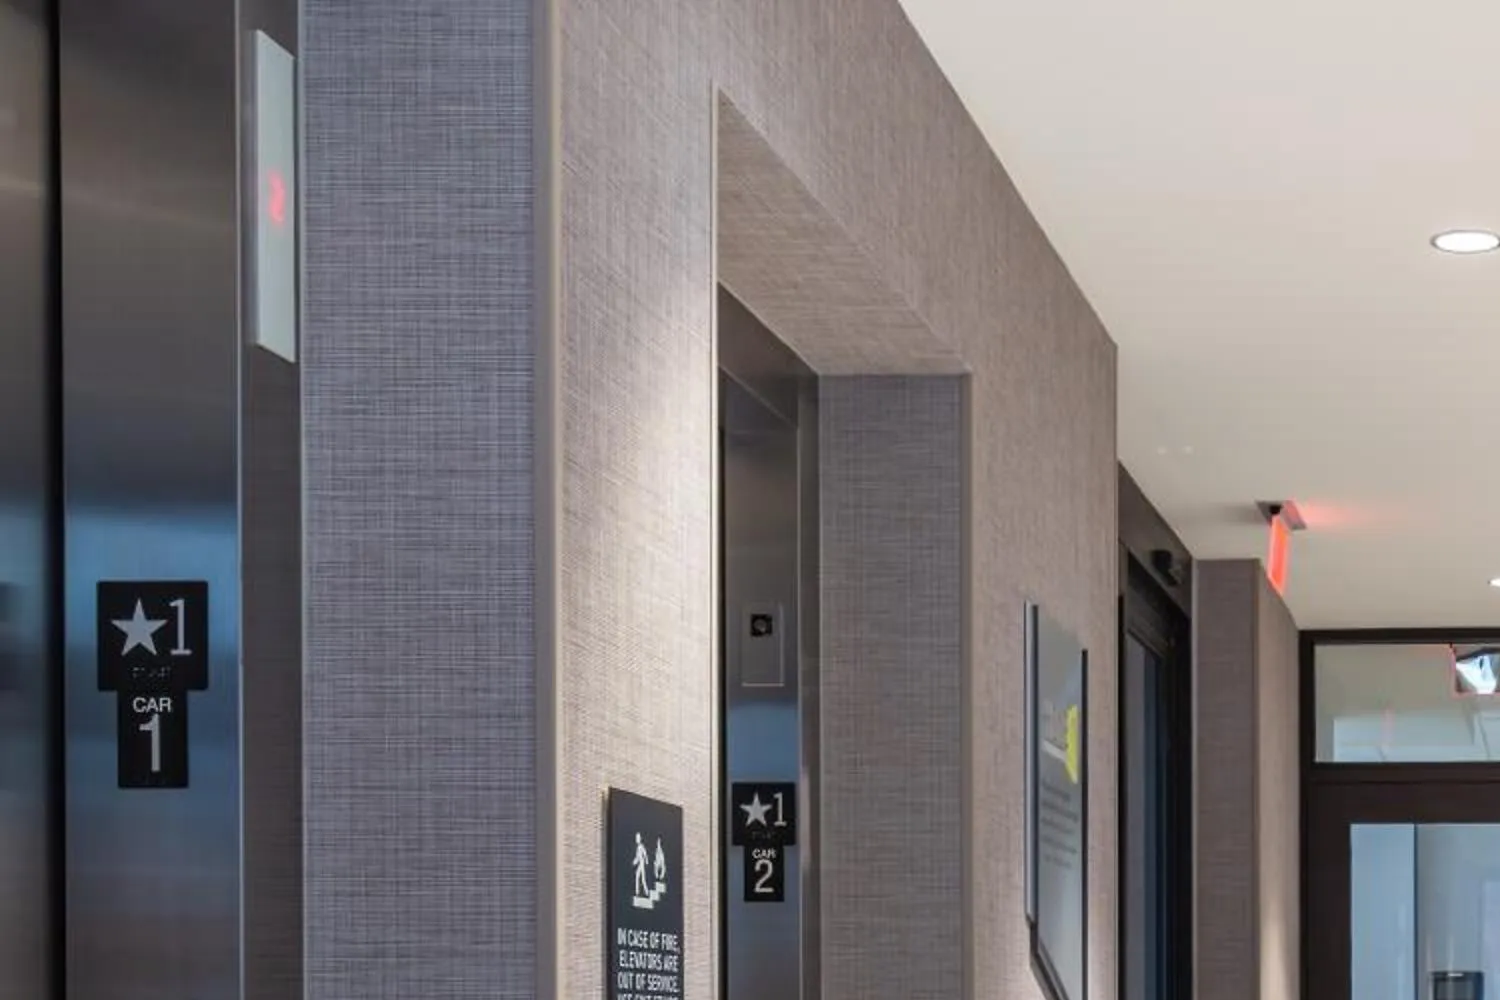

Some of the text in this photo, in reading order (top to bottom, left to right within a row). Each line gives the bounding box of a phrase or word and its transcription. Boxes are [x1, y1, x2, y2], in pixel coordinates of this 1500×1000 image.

[169, 598, 192, 655] 1
[133, 697, 172, 713] CAR
[139, 714, 161, 772] 1
[773, 792, 787, 827] 1
[752, 847, 776, 859] CAR
[754, 859, 774, 893] 2
[617, 927, 627, 946] IN
[628, 929, 648, 949] CASE
[649, 931, 660, 950] OF
[619, 950, 679, 973] ELEVATORS ARE
[617, 971, 633, 990] OUT
[635, 972, 646, 991] OF
